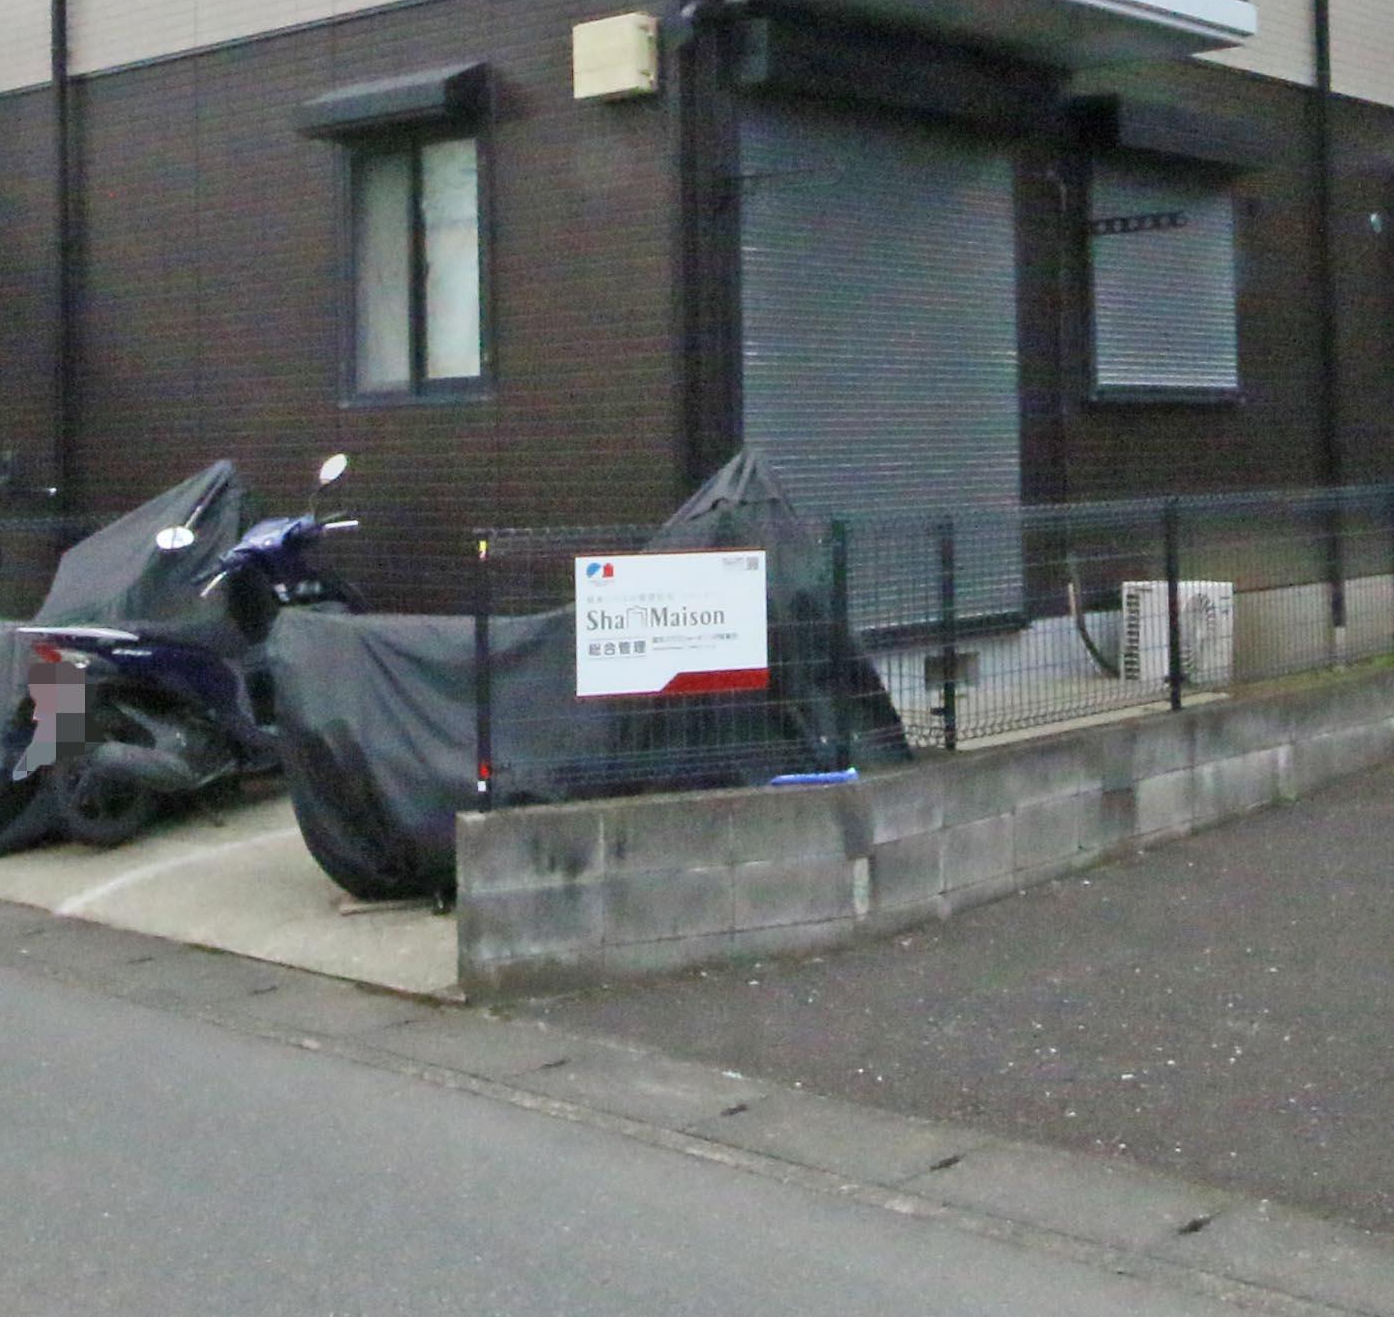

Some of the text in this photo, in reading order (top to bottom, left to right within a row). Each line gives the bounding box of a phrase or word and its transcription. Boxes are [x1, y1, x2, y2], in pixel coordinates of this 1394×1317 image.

[586, 606, 726, 632] Sha Maison
[588, 640, 647, 657] 総合管理
